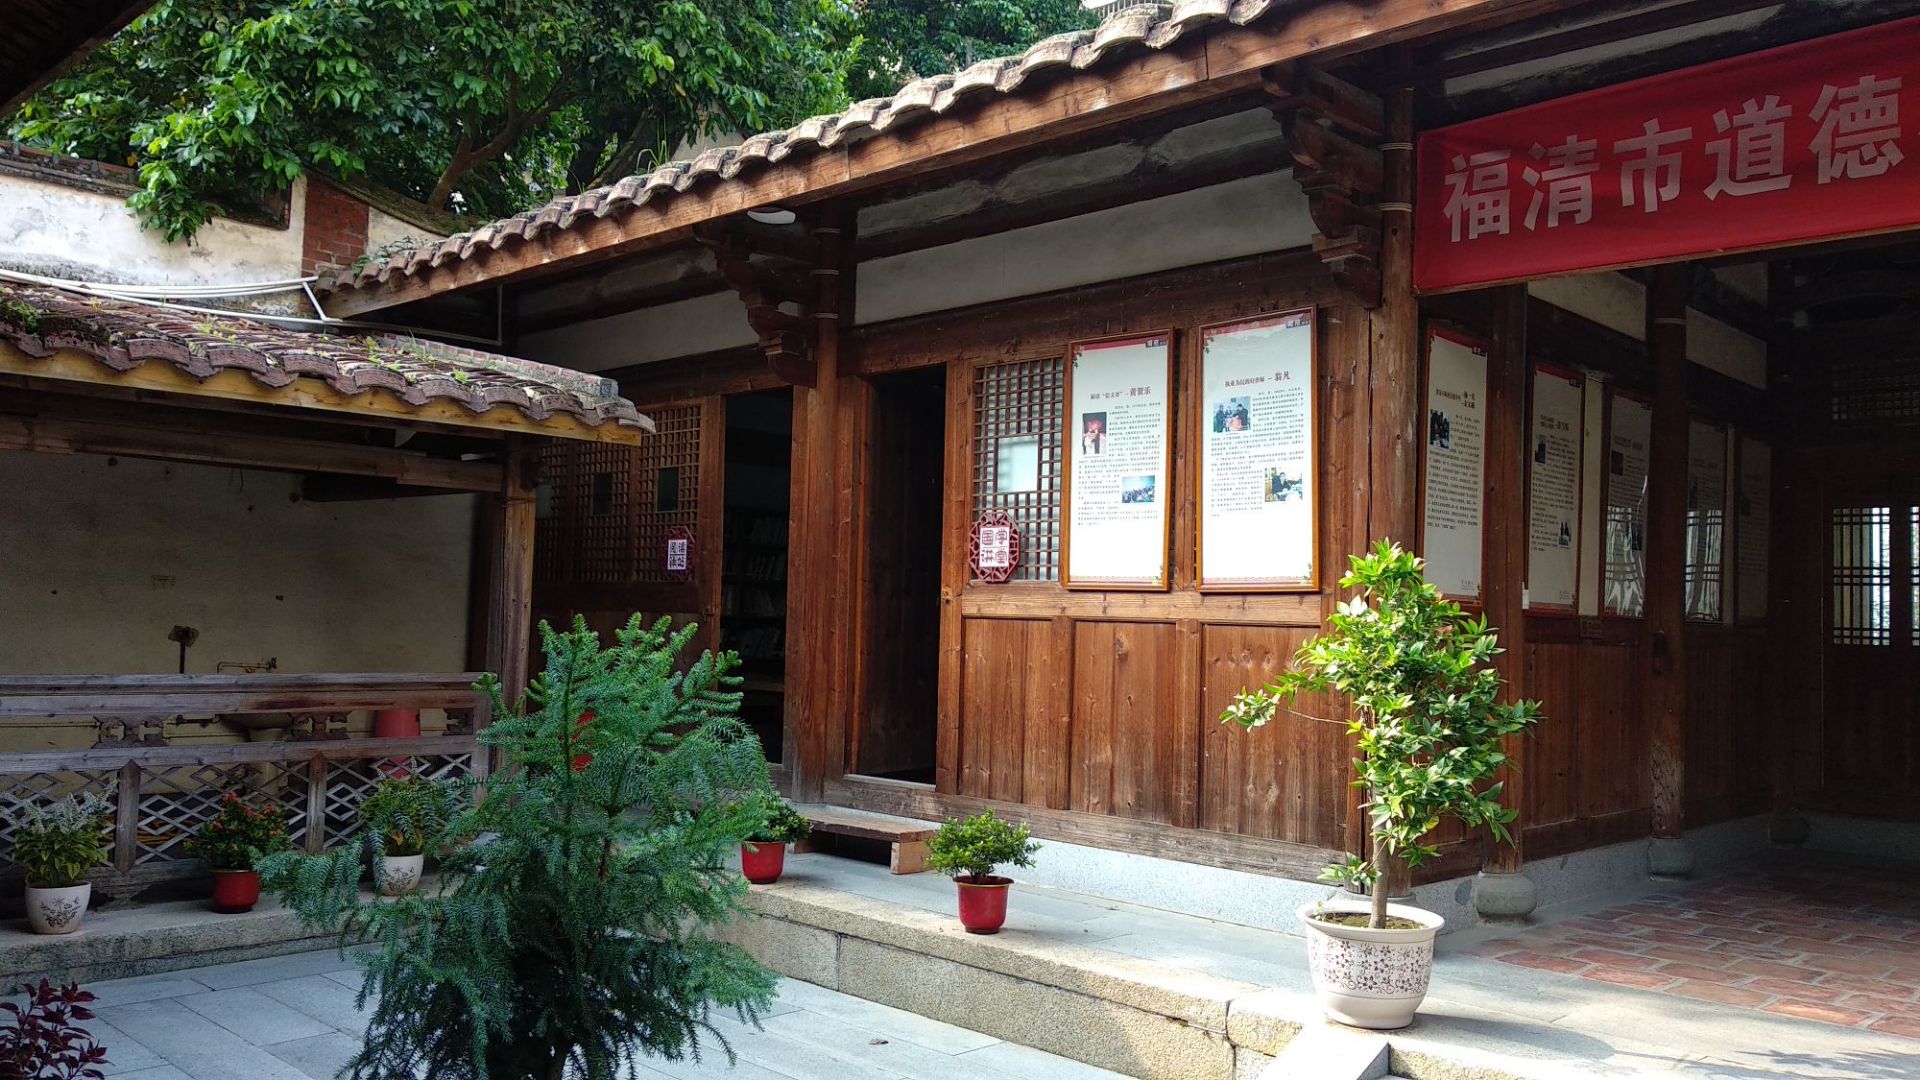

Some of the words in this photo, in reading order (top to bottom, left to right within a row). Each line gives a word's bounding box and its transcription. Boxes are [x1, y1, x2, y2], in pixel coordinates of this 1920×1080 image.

[1443, 74, 1905, 243] 福清市道德
